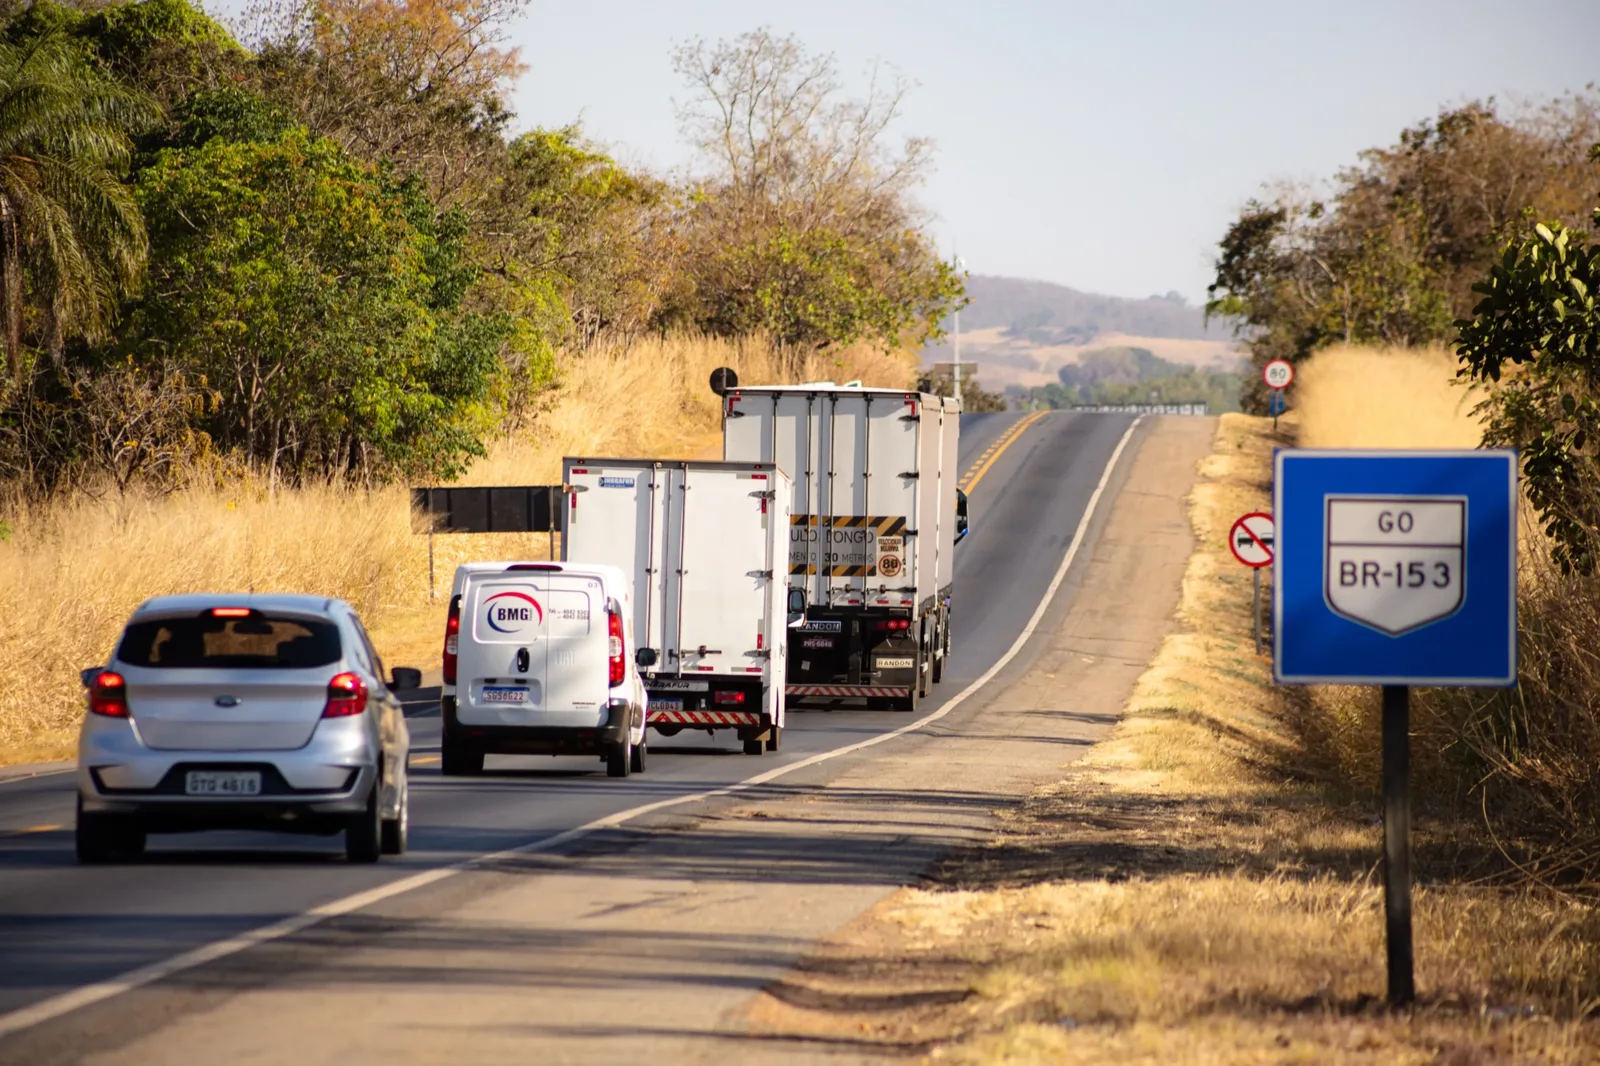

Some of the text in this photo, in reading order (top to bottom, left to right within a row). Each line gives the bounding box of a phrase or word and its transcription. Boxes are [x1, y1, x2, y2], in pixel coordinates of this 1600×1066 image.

[1269, 367, 1286, 379] 80
[1378, 510, 1414, 534] GO
[790, 528, 818, 542] ULO
[824, 552, 839, 563] 30
[882, 559, 898, 569] 80
[1340, 561, 1450, 588] BR-153
[497, 608, 529, 621] BMG
[647, 701, 679, 710] CL0D43
